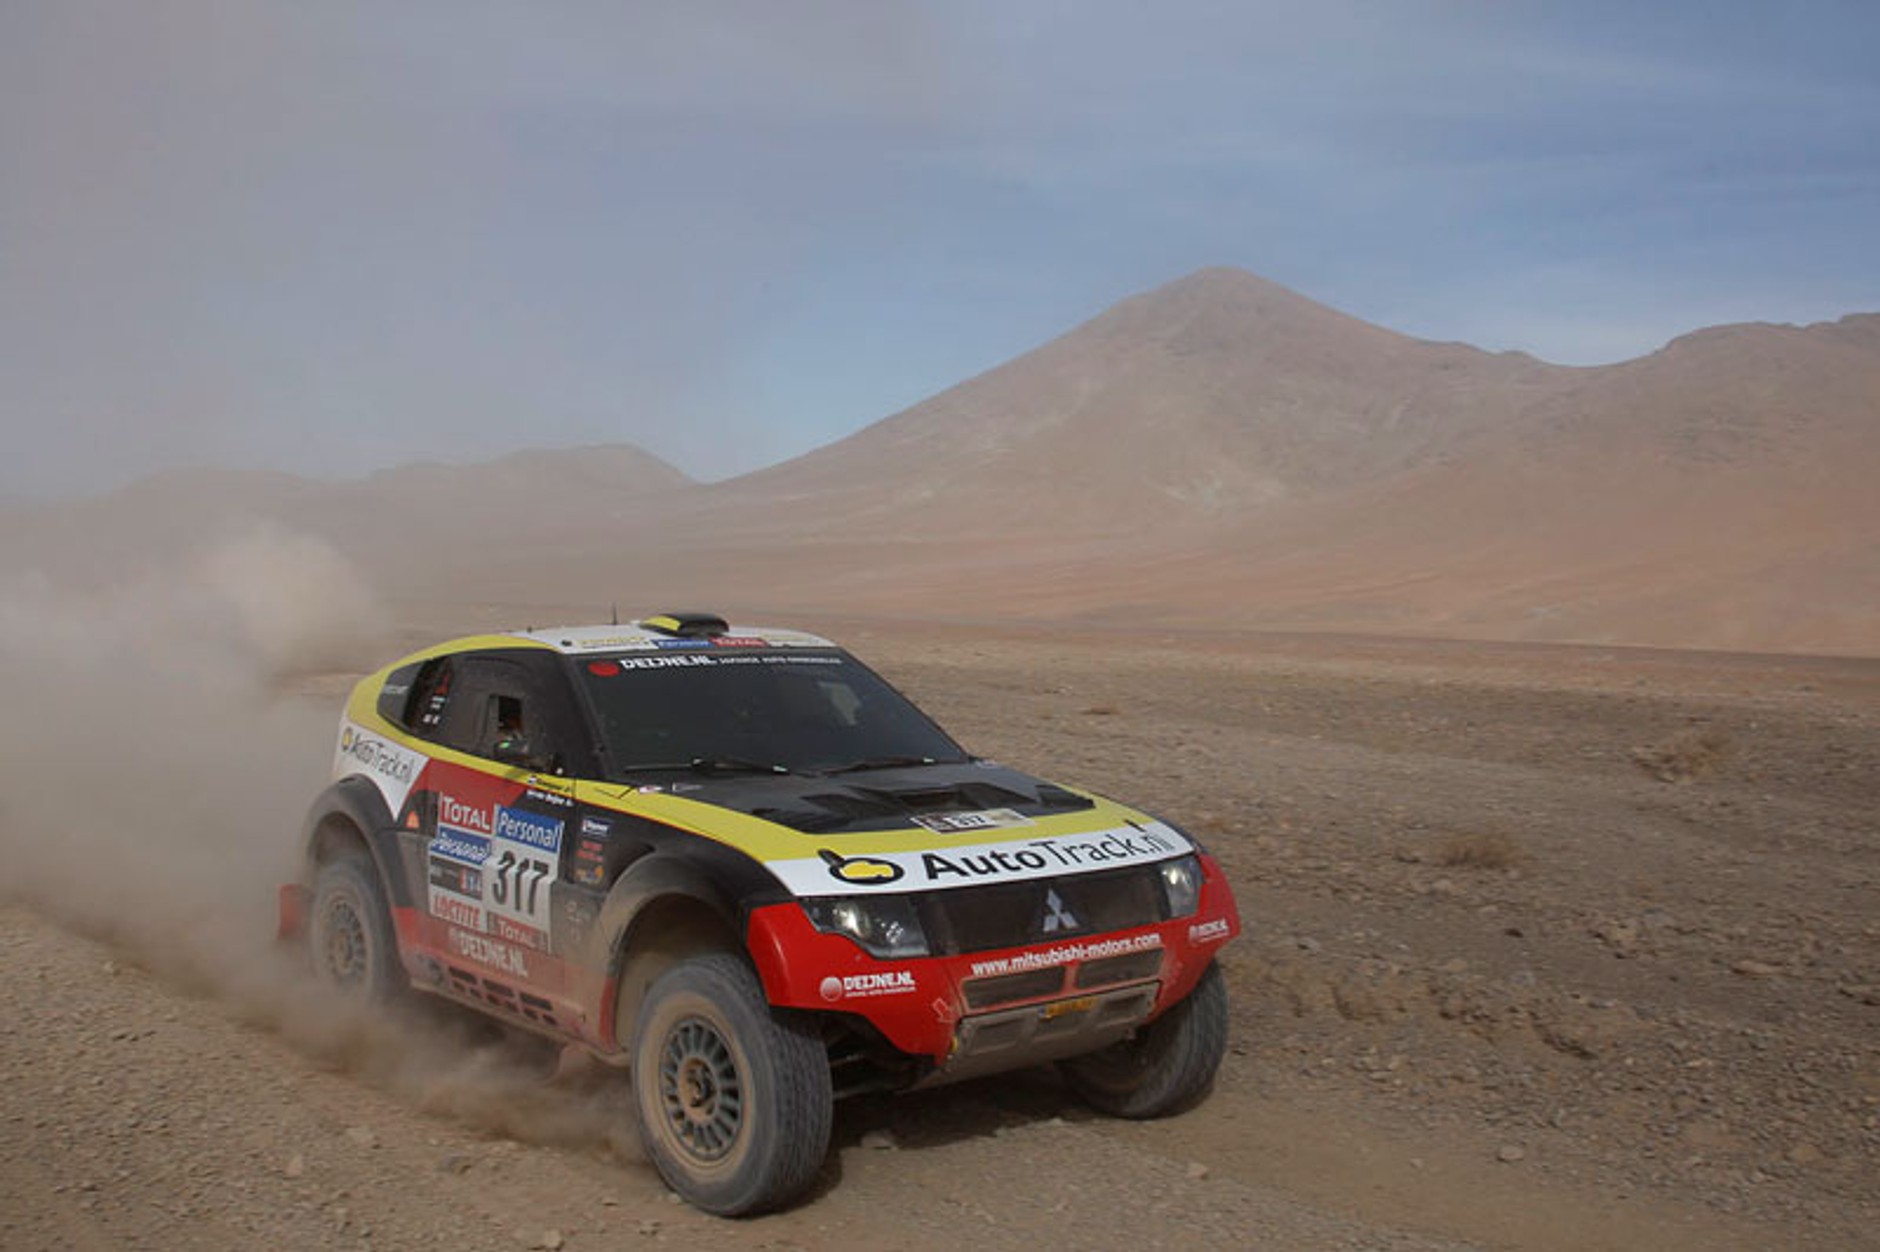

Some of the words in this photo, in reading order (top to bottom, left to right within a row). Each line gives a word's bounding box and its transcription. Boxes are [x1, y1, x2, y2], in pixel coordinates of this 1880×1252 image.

[443, 796, 491, 831] TOTAL
[499, 810, 560, 848] Personal
[920, 833, 1176, 881] AutoTrack.nl
[492, 850, 549, 916] 317
[971, 932, 1162, 976] www.mitsubishi-motors.com
